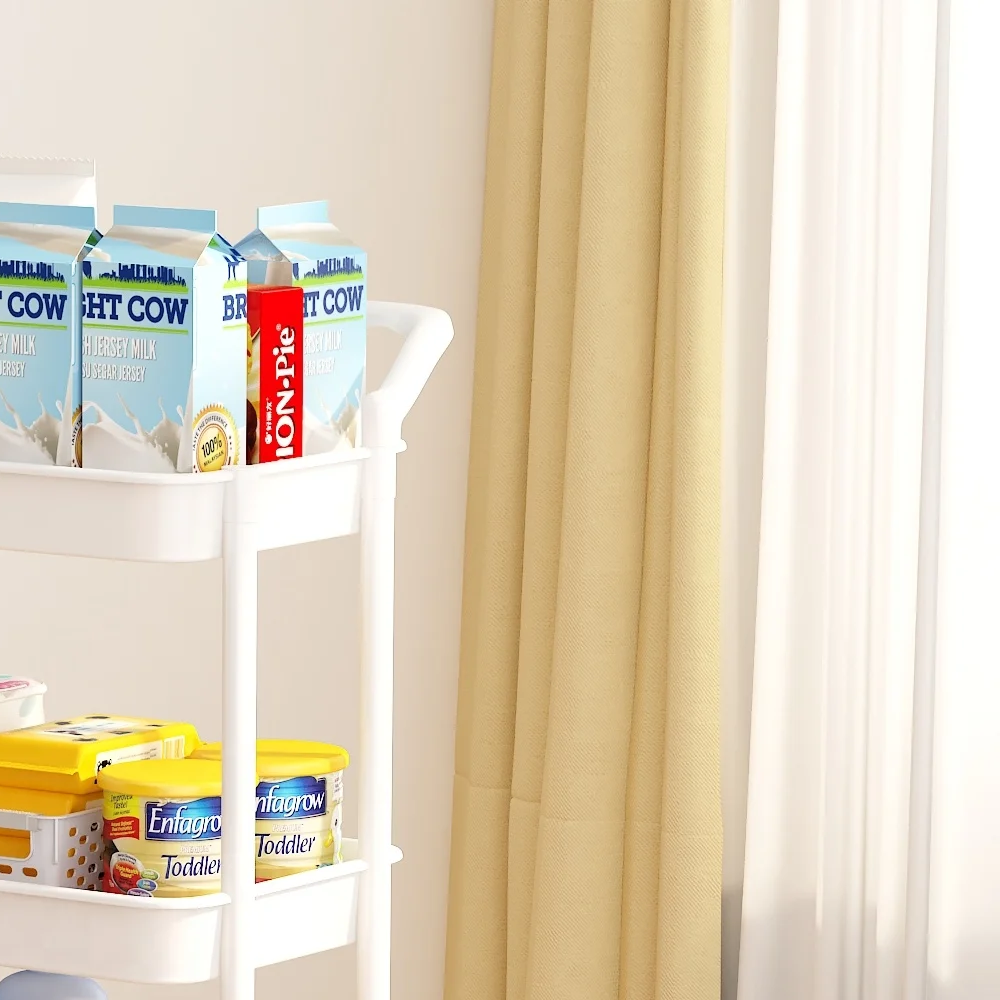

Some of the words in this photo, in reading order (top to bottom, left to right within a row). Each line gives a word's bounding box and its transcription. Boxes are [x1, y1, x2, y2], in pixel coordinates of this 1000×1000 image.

[8, 291, 67, 320] COW
[127, 295, 188, 324] COW
[323, 285, 363, 315] COW
[12, 334, 36, 355] MILK
[94, 336, 129, 359] JERSEY
[132, 338, 157, 360] MILK
[0, 361, 26, 377] JERSEY
[93, 363, 117, 379] SEGAR
[118, 365, 146, 382] JERSEY
[202, 433, 222, 457] 100%
[255, 785, 325, 817] nfagrow
[148, 805, 221, 839] Enfagro
[255, 833, 315, 858] Toddler
